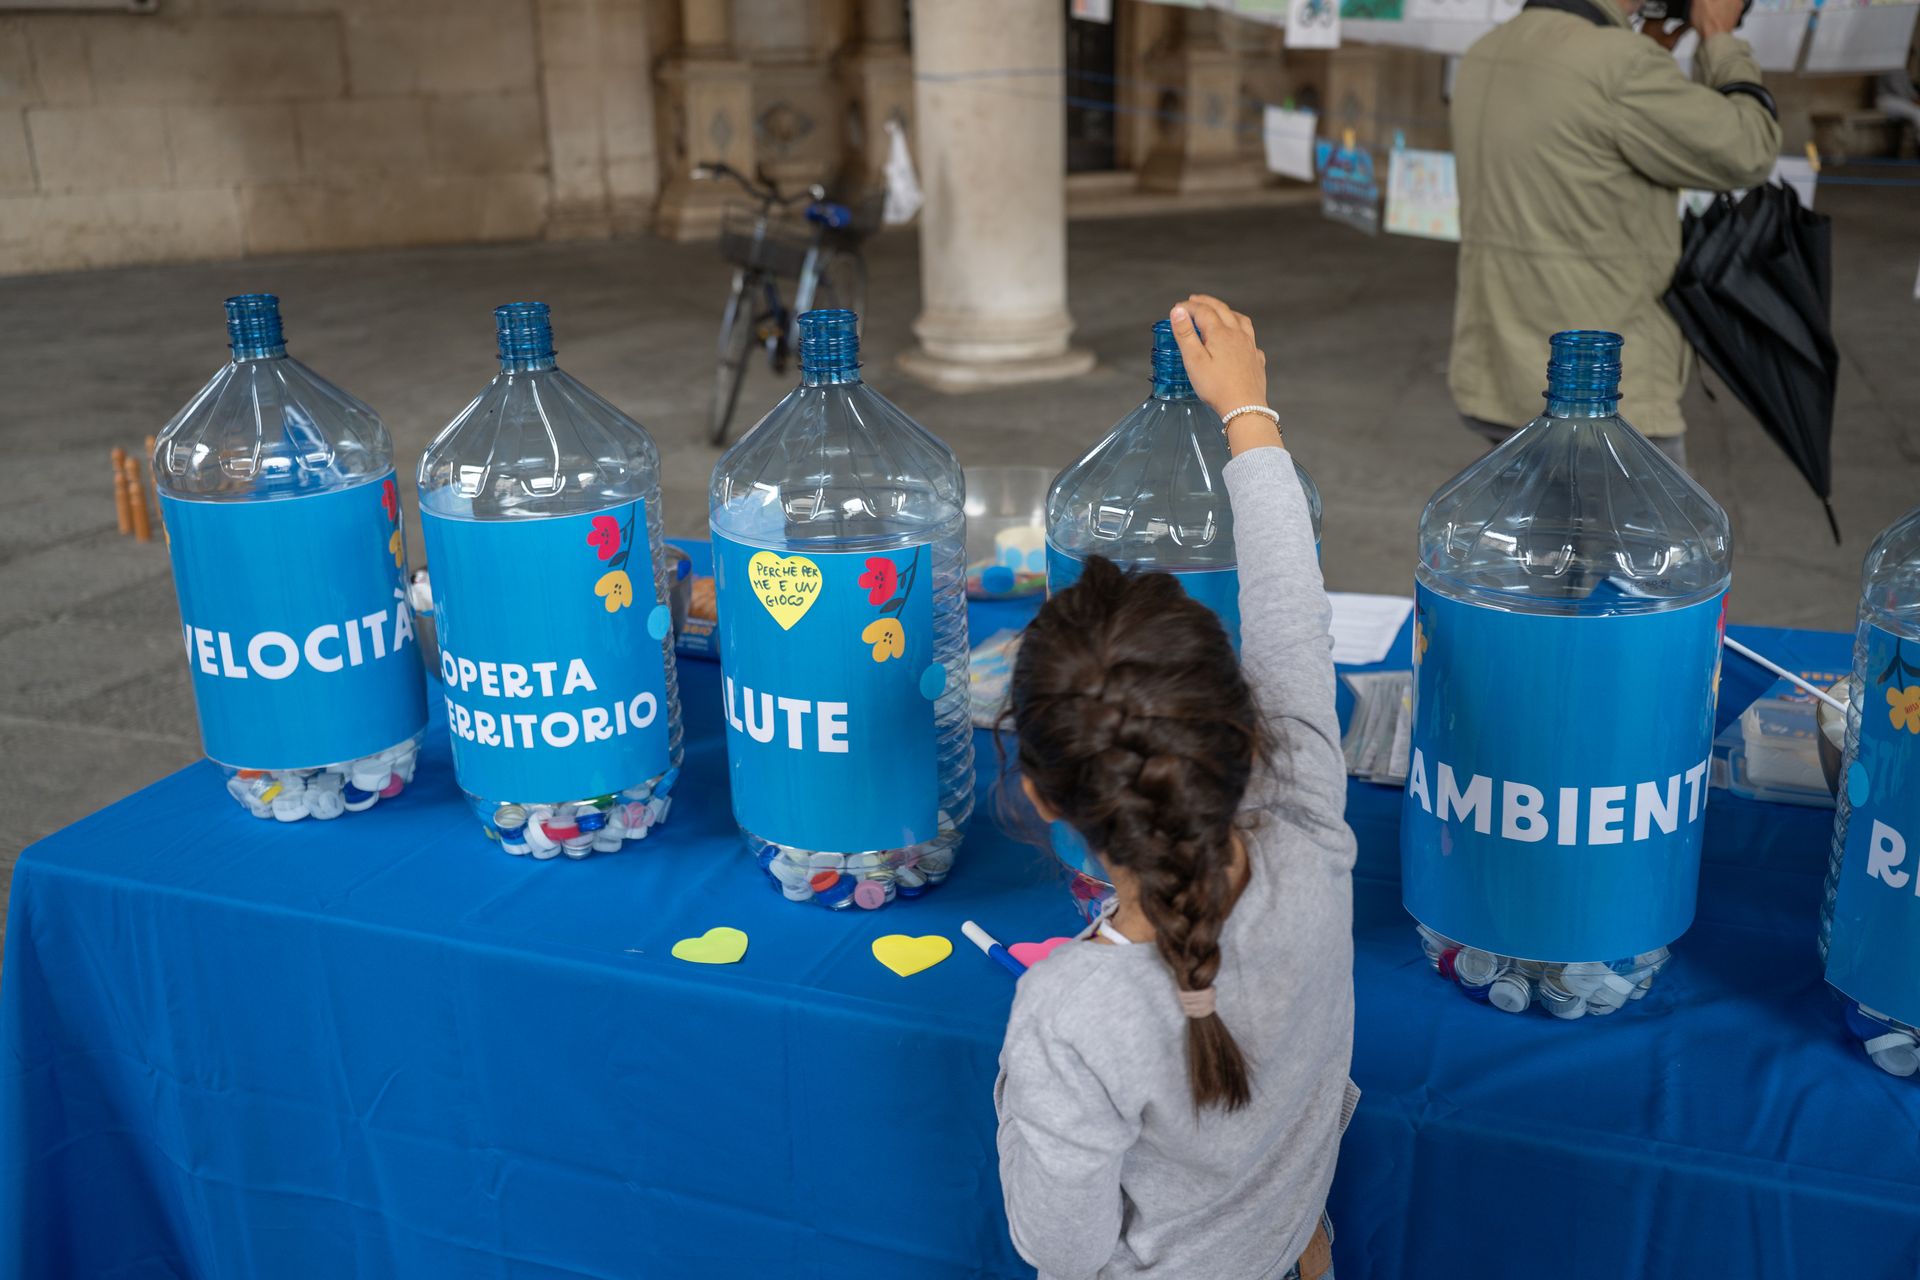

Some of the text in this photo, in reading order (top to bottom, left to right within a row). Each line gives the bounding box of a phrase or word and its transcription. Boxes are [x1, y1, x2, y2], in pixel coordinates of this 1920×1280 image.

[753, 579, 772, 591] ME
[795, 582, 818, 594] UN
[765, 594, 804, 607] GIOCO
[439, 645, 598, 698] OPERTA
[722, 676, 849, 753] LUTE
